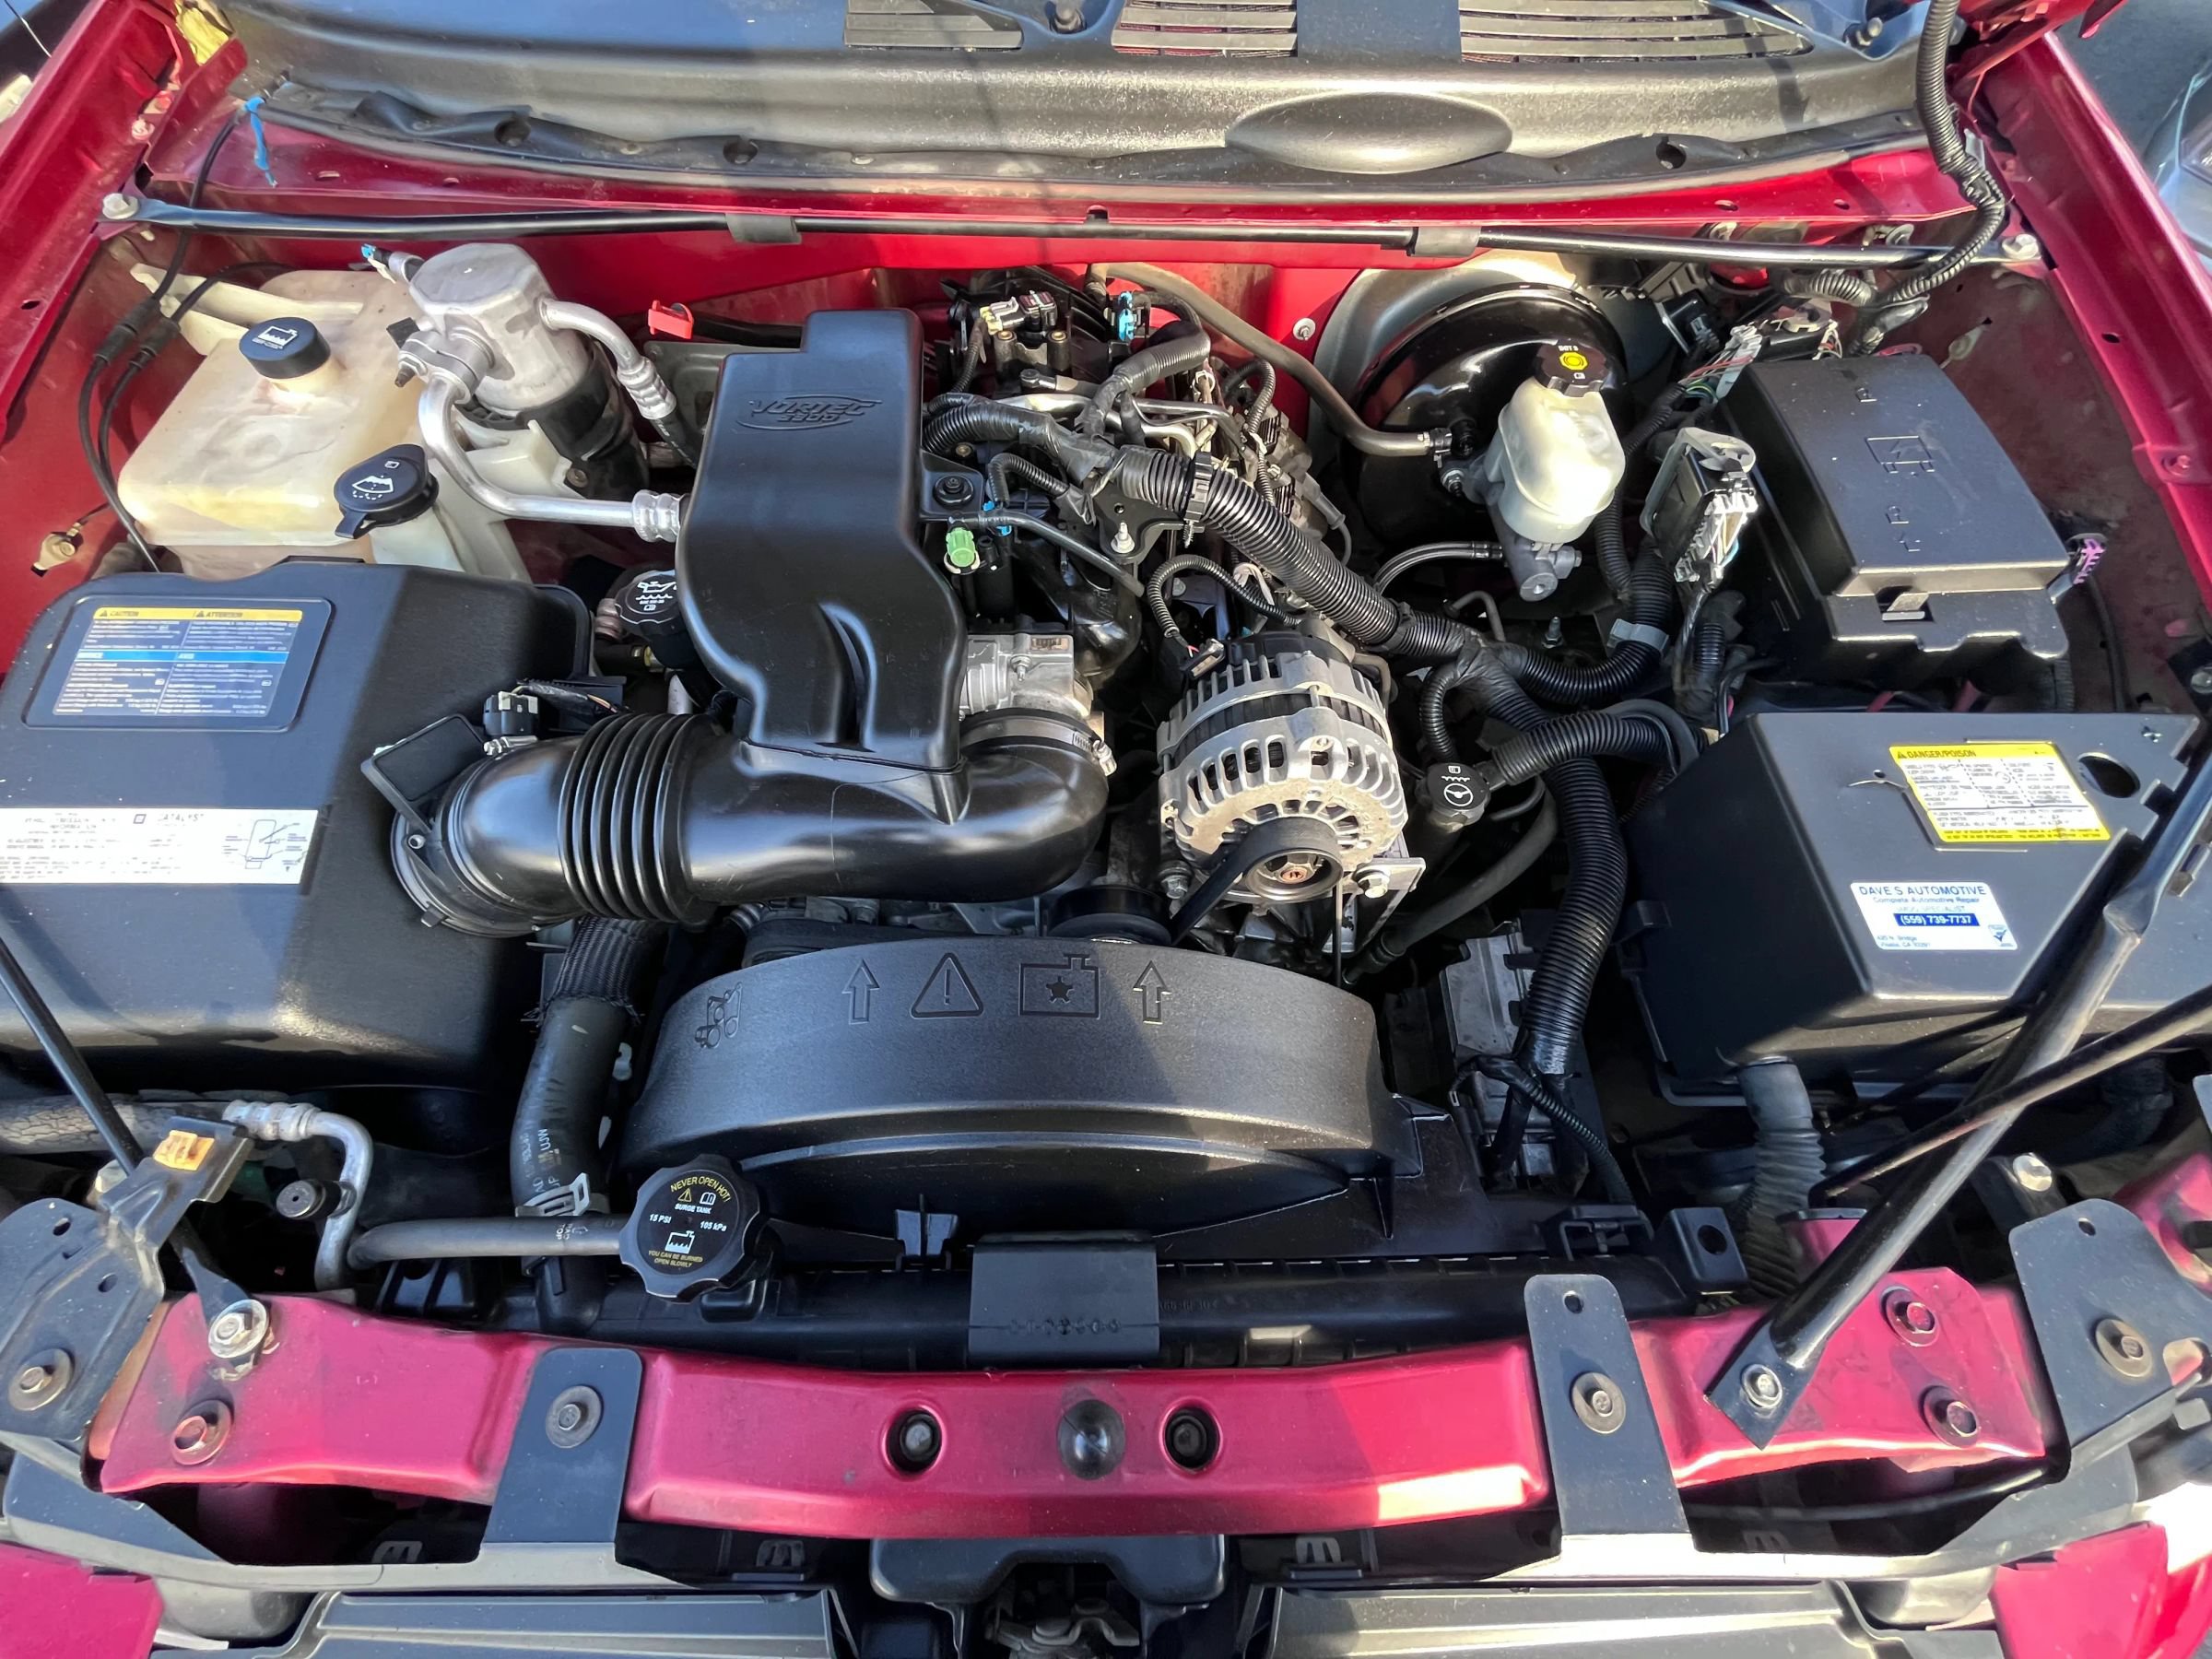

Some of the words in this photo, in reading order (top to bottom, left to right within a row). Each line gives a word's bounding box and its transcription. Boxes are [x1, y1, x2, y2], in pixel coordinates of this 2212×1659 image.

[748, 398, 875, 417] VORTEC
[1906, 749, 1977, 759] DANGER/POISON
[1859, 886, 1903, 896] DAVES
[1907, 886, 1987, 896] AUTOMOTIVE
[1900, 914, 1927, 925] (559)
[1927, 914, 1971, 925] 739-7737
[670, 1176, 698, 1193] NEVER
[698, 1175, 719, 1190] OPEN
[716, 1185, 732, 1203] HOT!
[674, 1203, 697, 1213] SURGE
[696, 1206, 712, 1214] TANK
[649, 1213, 658, 1222] 15
[658, 1214, 672, 1224] PSI
[700, 1220, 712, 1230] 105
[712, 1222, 727, 1232] kPa
[648, 1249, 660, 1257] YOU
[680, 1253, 704, 1263] BURNED
[669, 1259, 693, 1268] SLOWLY
